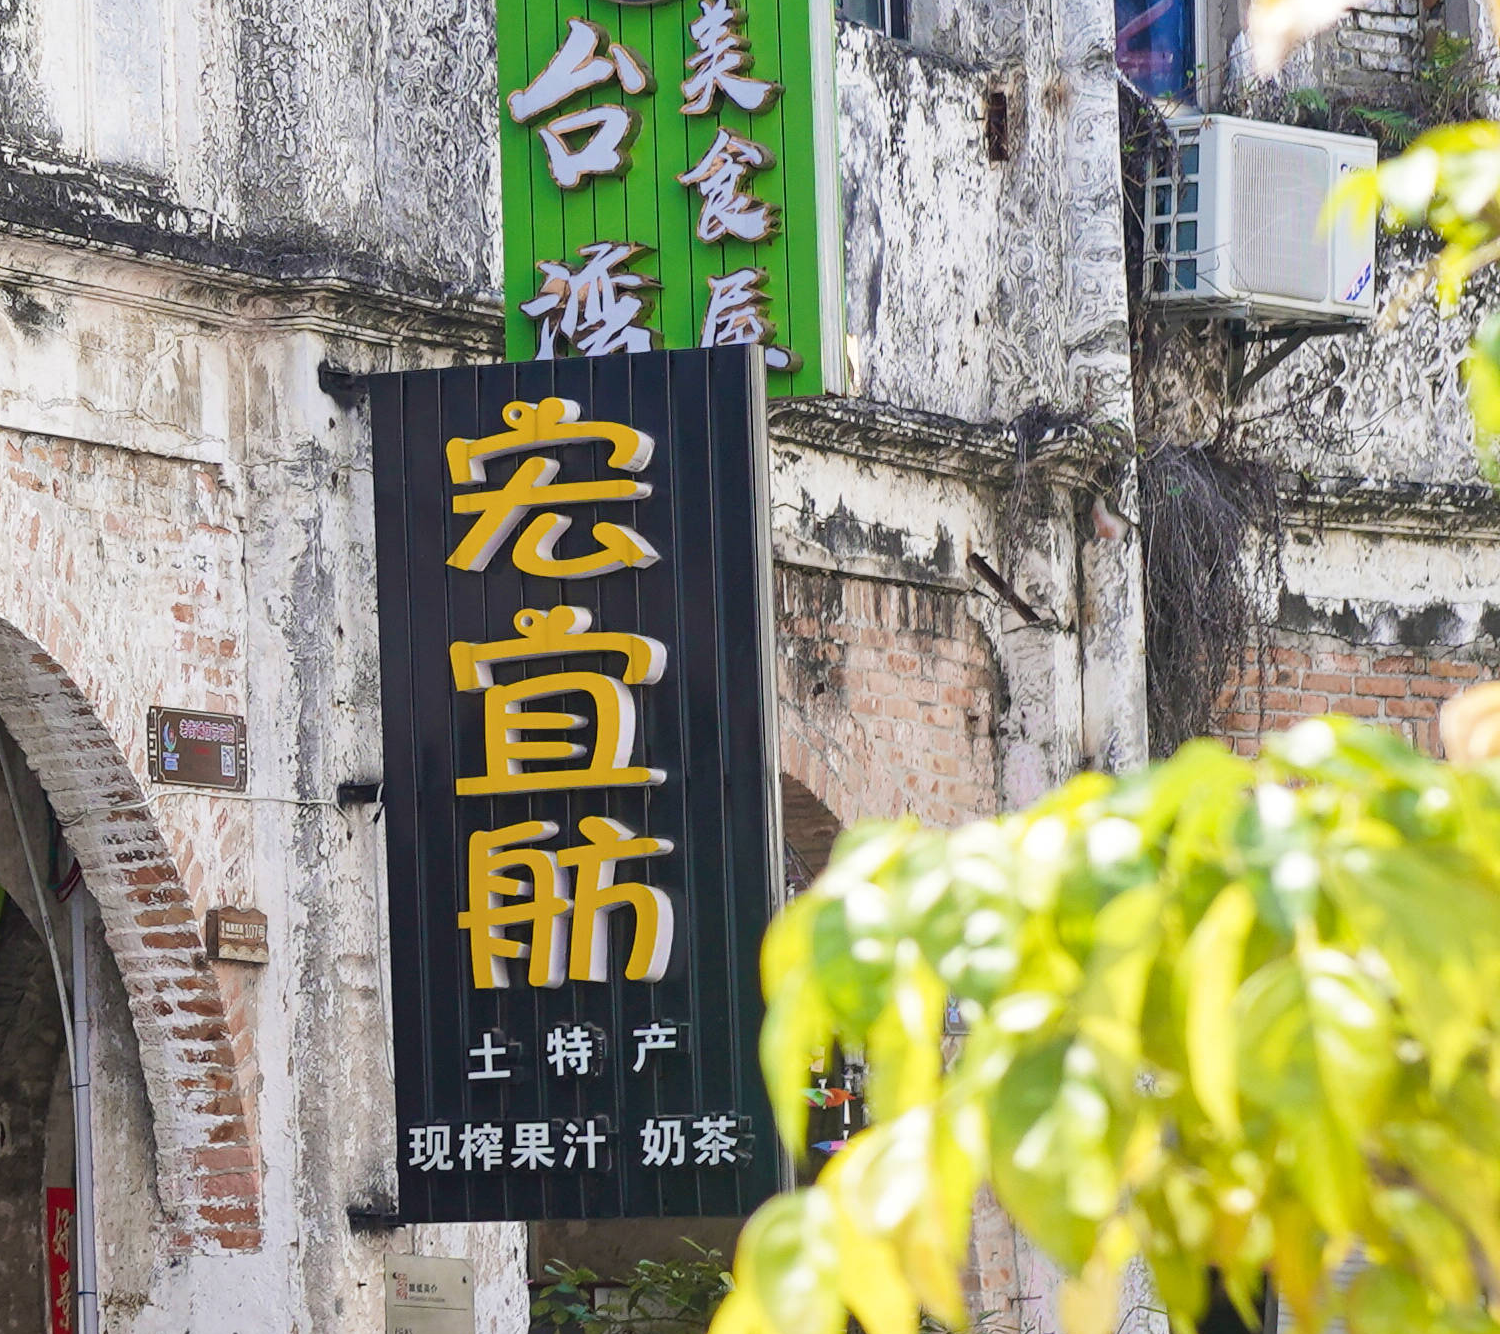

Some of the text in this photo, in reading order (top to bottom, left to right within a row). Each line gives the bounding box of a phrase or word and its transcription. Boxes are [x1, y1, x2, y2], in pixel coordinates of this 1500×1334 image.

[509, 18, 653, 359] 台湾
[446, 396, 674, 990] 宏宜舫
[409, 1116, 738, 1172] 现榨果汁 奶茶
[467, 1023, 678, 1080] 土特产
